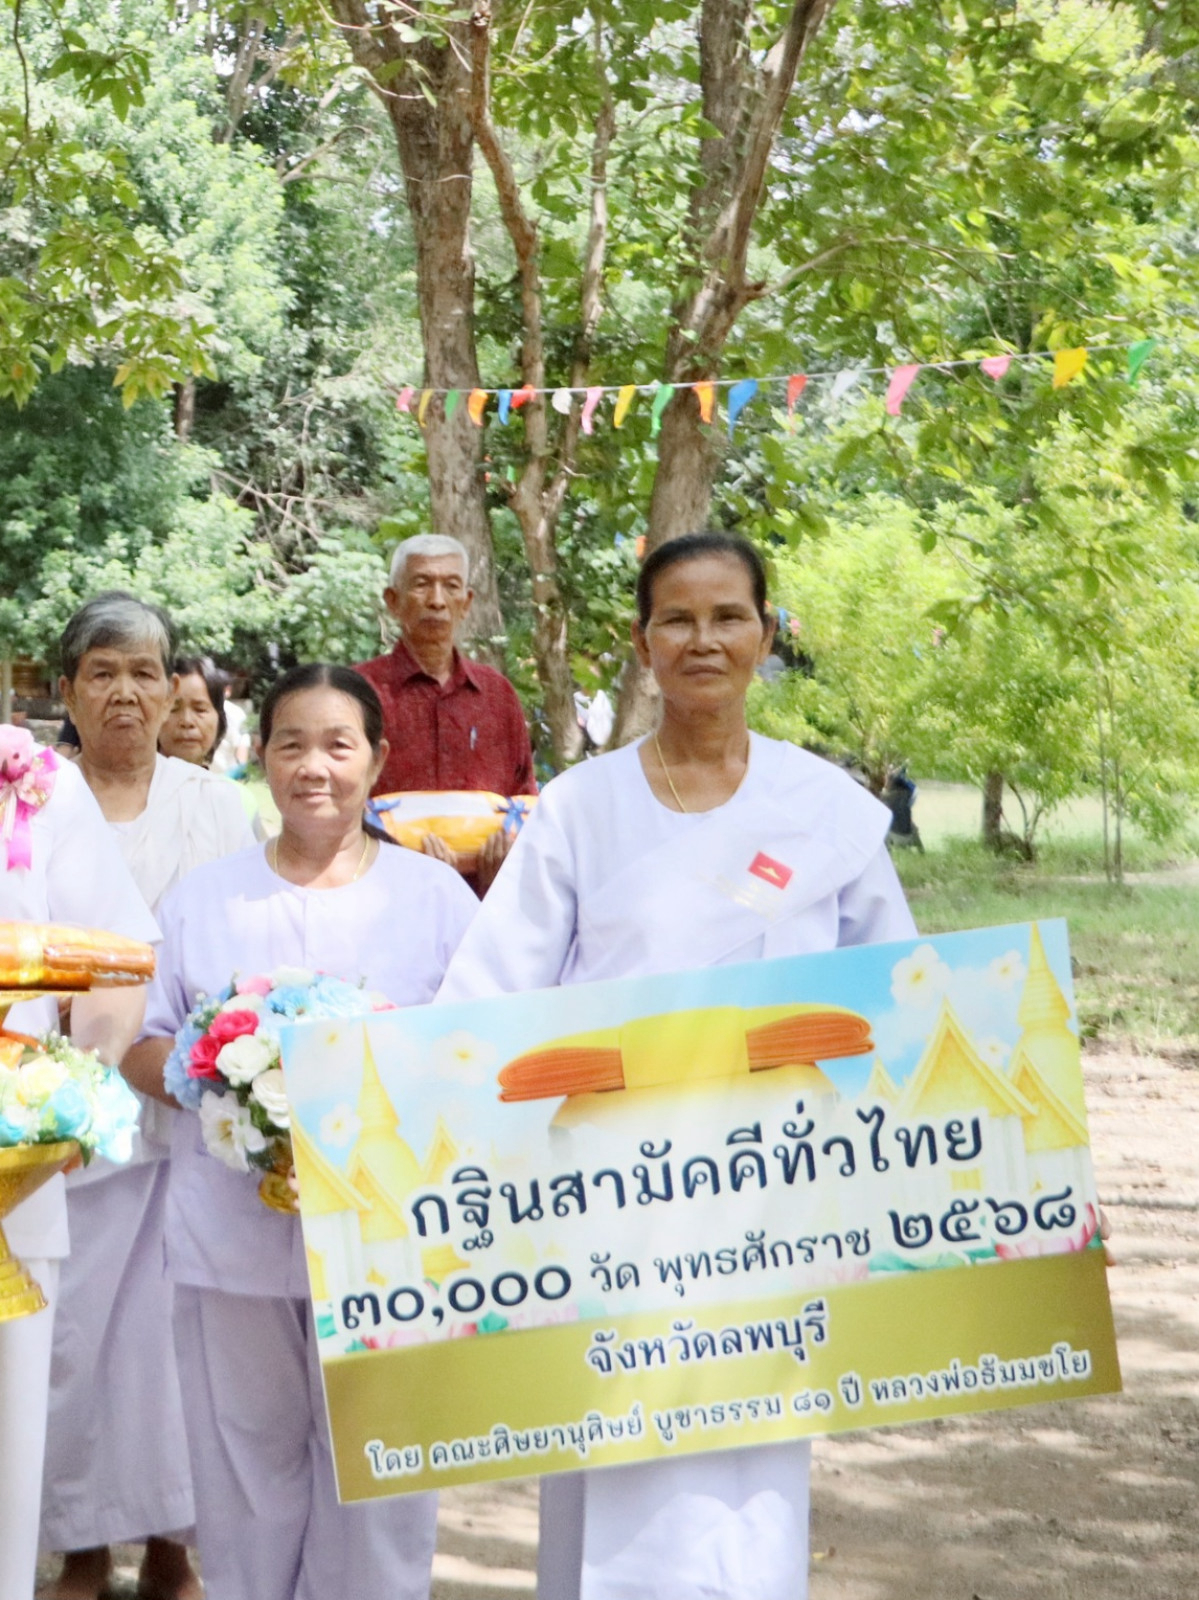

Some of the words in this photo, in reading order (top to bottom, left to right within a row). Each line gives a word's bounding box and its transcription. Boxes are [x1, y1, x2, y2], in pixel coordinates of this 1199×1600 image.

[411, 1099, 983, 1252] กฐินสามัคคีทั่วไทย
[341, 1264, 572, 1331] ๓๐,๐๐๐
[589, 1251, 641, 1293] วัด
[653, 1227, 871, 1298] พุทธศักราช
[887, 1185, 1077, 1250] ๒๕๖๘
[587, 1299, 828, 1374] จังหวัดลพบุรี
[369, 1443, 420, 1475] โดย
[431, 1403, 643, 1466] คณะศิษยานุศิษย์
[653, 1394, 782, 1442] บูชาธรรม
[841, 1376, 861, 1405] ปี
